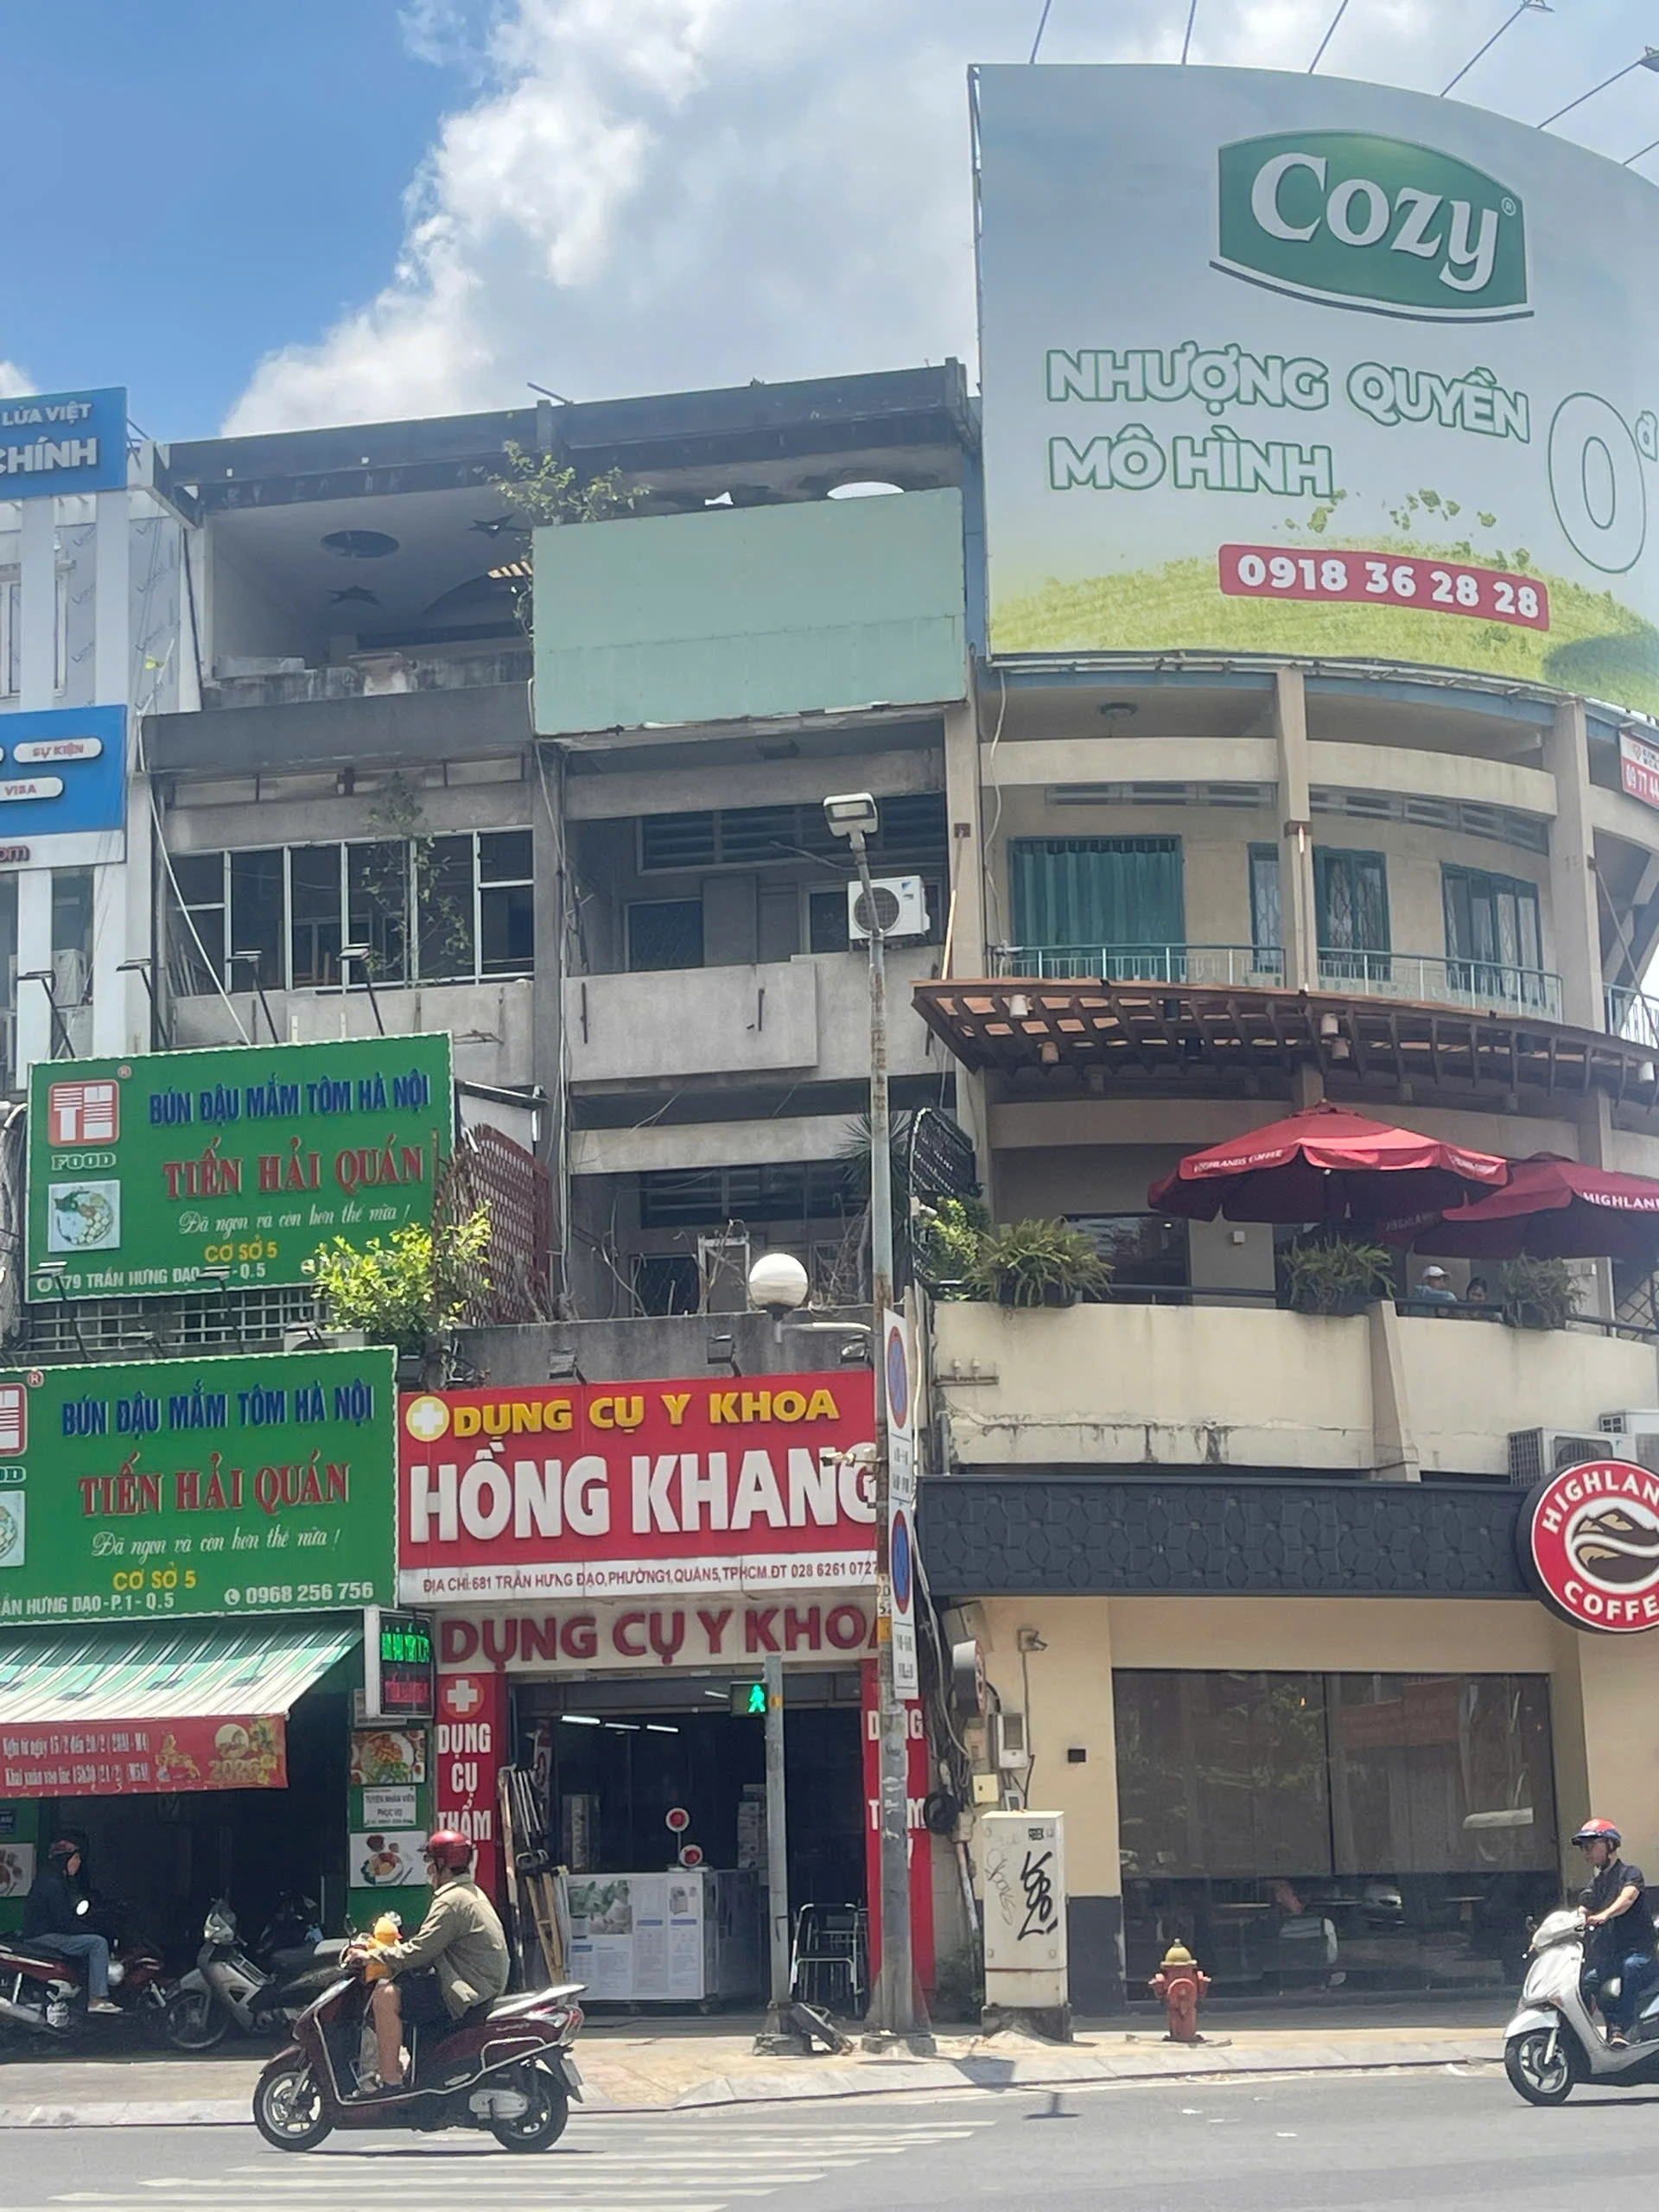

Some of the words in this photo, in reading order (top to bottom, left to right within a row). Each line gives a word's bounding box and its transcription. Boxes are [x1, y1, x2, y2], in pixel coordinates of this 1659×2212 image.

[1251, 152, 1499, 292] Cozy
[45, 401, 92, 424] VIỆT
[1046, 340, 1329, 416] NHƯỢNG
[1346, 367, 1530, 443] QUYỀN
[1049, 424, 1166, 489] MÔ
[1173, 425, 1334, 498] HÌNH
[1238, 555, 1348, 592] 0918
[1365, 563, 1415, 597] 36
[1431, 571, 1479, 608] 28
[1494, 581, 1539, 619] 28
[4, 785, 37, 796] VISA
[149, 1086, 194, 1127] BÚN
[200, 1084, 241, 1127] ĐẬU
[246, 1071, 301, 1118] MẮM
[306, 1075, 353, 1114] TÔM
[359, 1071, 388, 1111] HÀ
[392, 1067, 431, 1113] NỘI
[51, 1152, 117, 1171] FOOD
[163, 1136, 243, 1199] TIẾN
[257, 1136, 321, 1193] HẢI
[335, 1133, 423, 1195] QUÁN
[267, 1242, 277, 1259] 5
[62, 1394, 109, 1437] BÚN
[117, 1389, 162, 1440] ĐẬU
[169, 1379, 228, 1431] MẮM
[238, 1383, 287, 1426] TÔM
[295, 1379, 327, 1422] HÀ
[334, 1377, 374, 1427] NỘI
[454, 1399, 572, 1440] DỤNG
[589, 1395, 644, 1433] CỤ
[661, 1394, 691, 1426] Y
[709, 1389, 839, 1424] KHOA
[78, 1451, 163, 1517] TIẾN
[175, 1452, 245, 1511] HẢI
[254, 1449, 351, 1516] QUÁN
[410, 1440, 609, 1543] HỒNG
[632, 1442, 877, 1535] KHANG
[184, 1570, 196, 1588] 5
[791, 1562, 813, 1579] 028
[817, 1561, 845, 1577] 6261
[245, 1585, 292, 1604] 0968
[297, 1583, 333, 1601] 256
[337, 1581, 373, 1599] 756
[442, 1617, 596, 1672] DỤNG
[612, 1611, 685, 1665] CỤ
[690, 1609, 734, 1654] Y
[745, 1605, 879, 1651] KHO
[437, 1724, 491, 1759] DỤNG
[868, 1709, 923, 1740] DG
[451, 1762, 478, 1797] CỤ
[868, 1797, 927, 1830] TM
